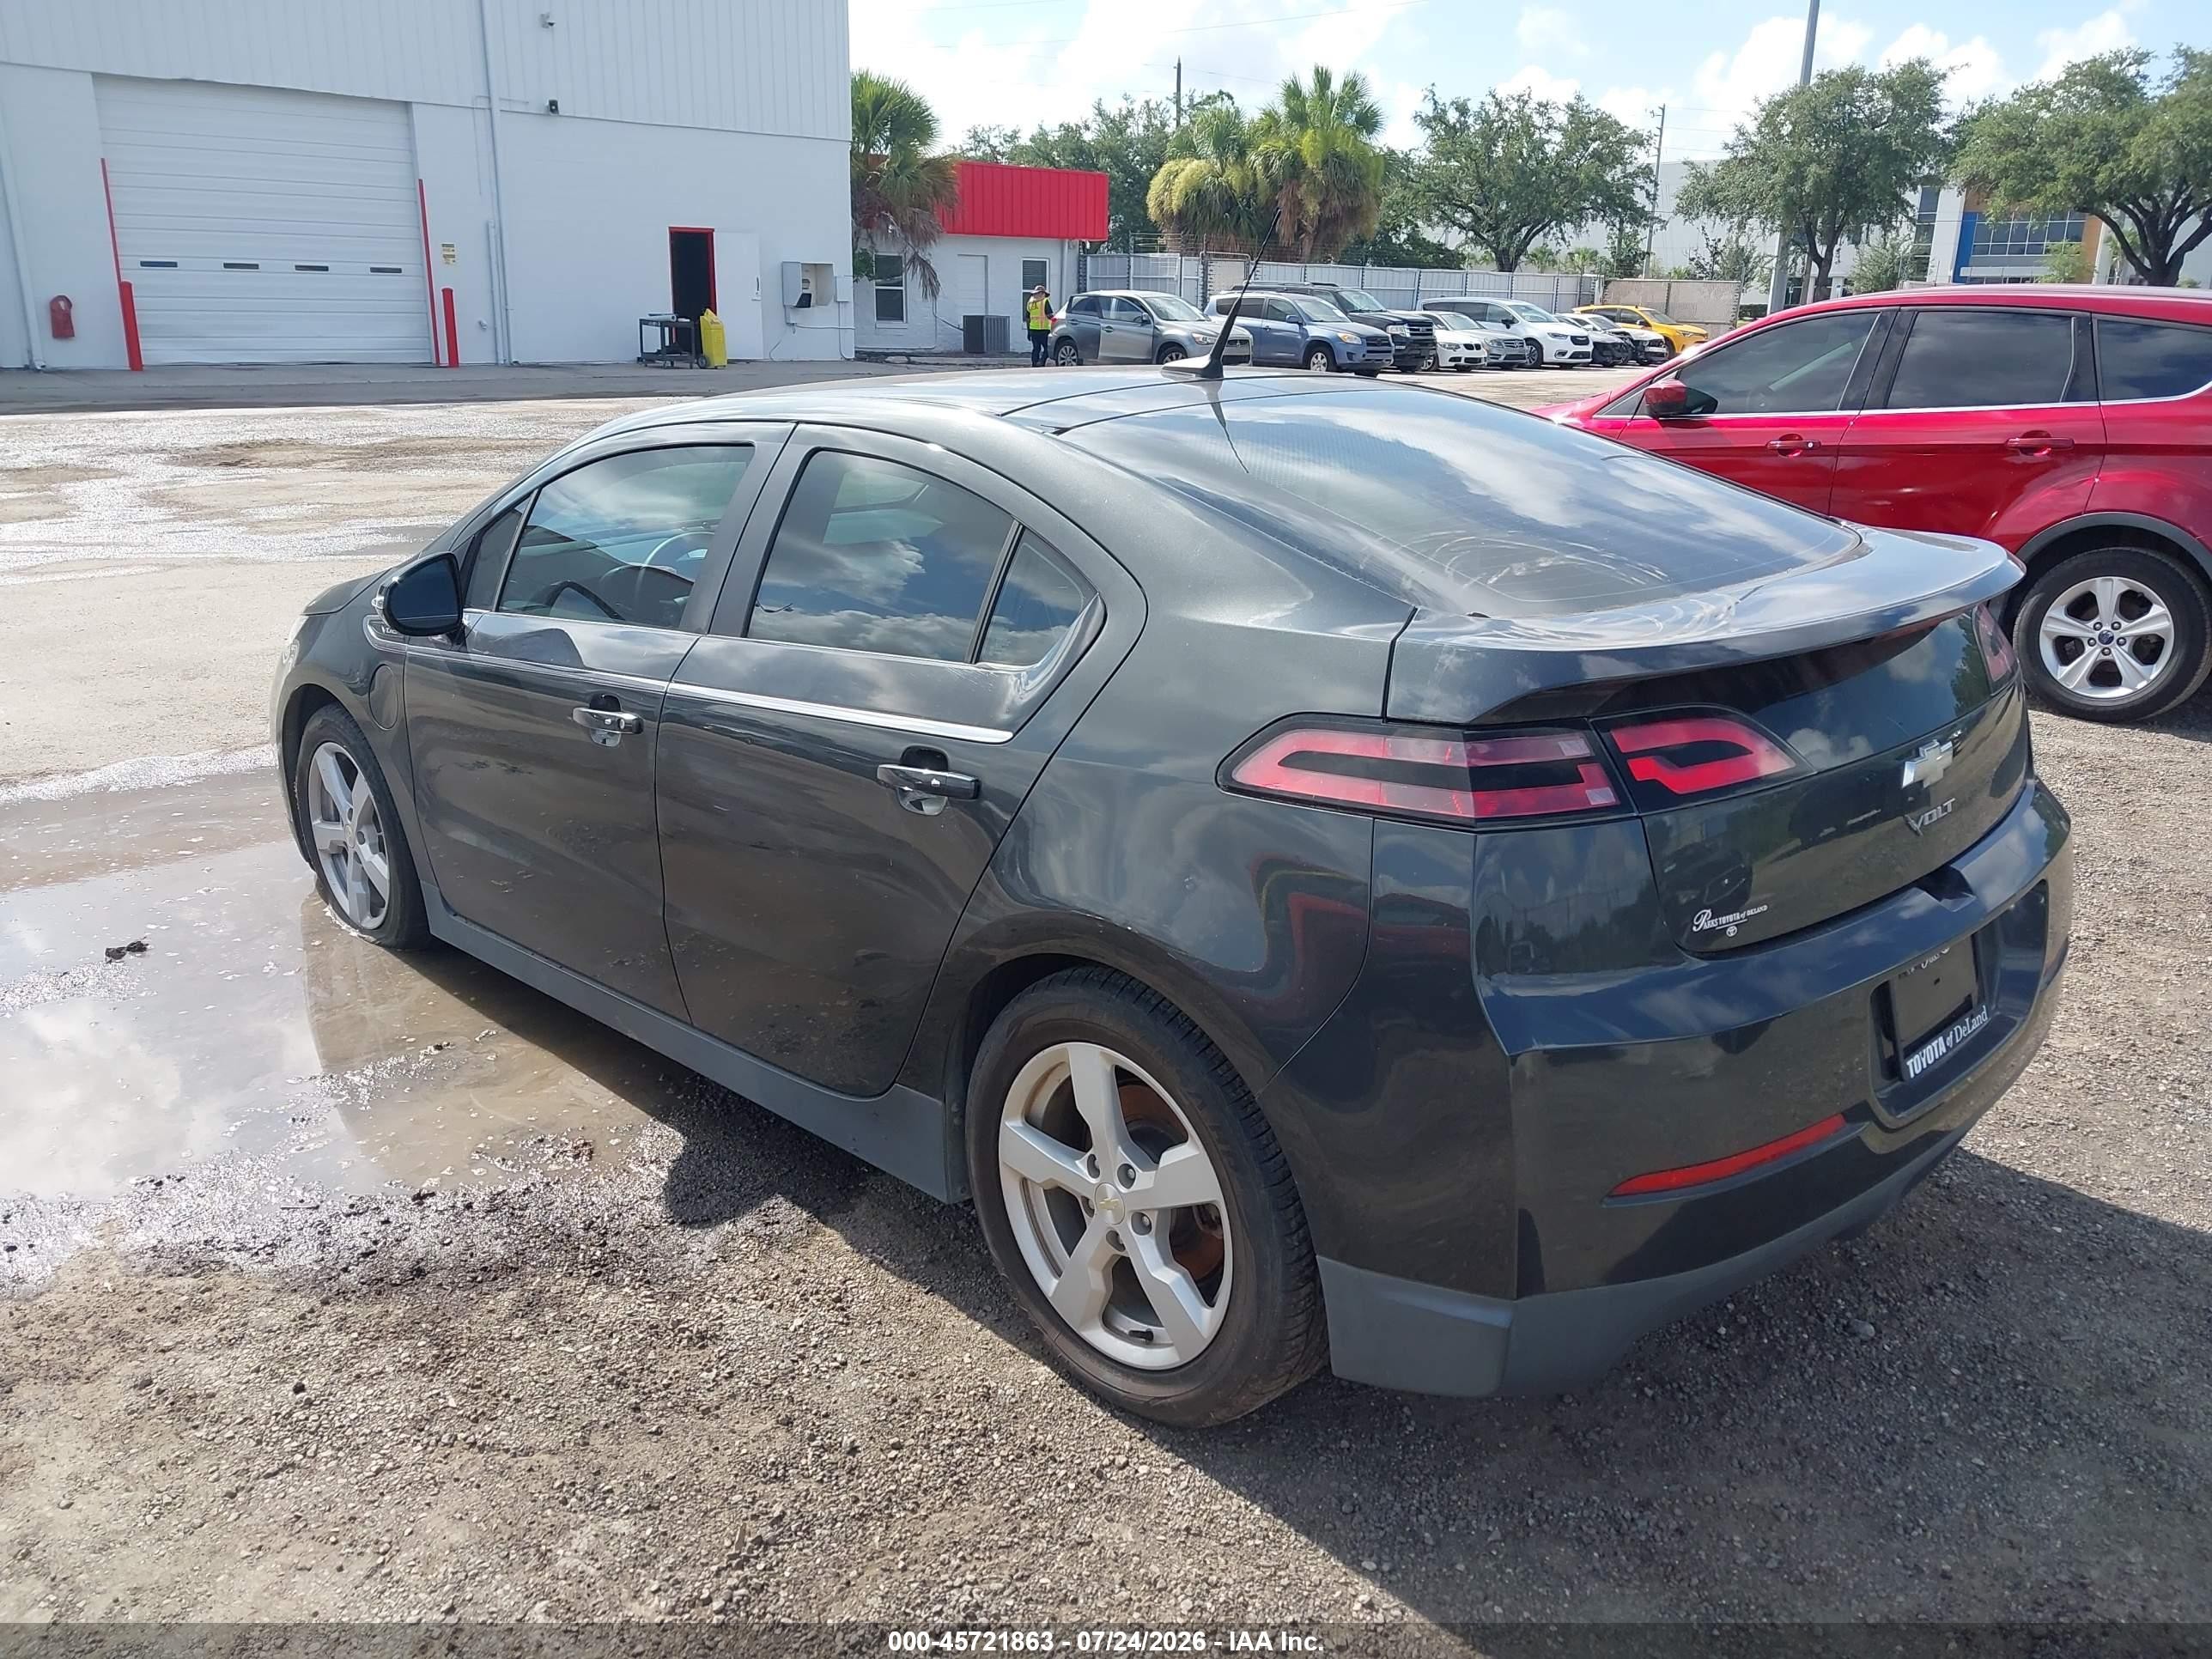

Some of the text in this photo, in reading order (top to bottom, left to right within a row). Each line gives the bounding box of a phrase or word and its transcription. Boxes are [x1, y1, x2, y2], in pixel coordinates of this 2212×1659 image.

[1905, 797, 1955, 836] VOLT
[1718, 912, 1740, 925] TOYOTA
[1740, 910, 1747, 919] of
[1906, 1005, 1988, 1079] TOYOTA of DeLand
